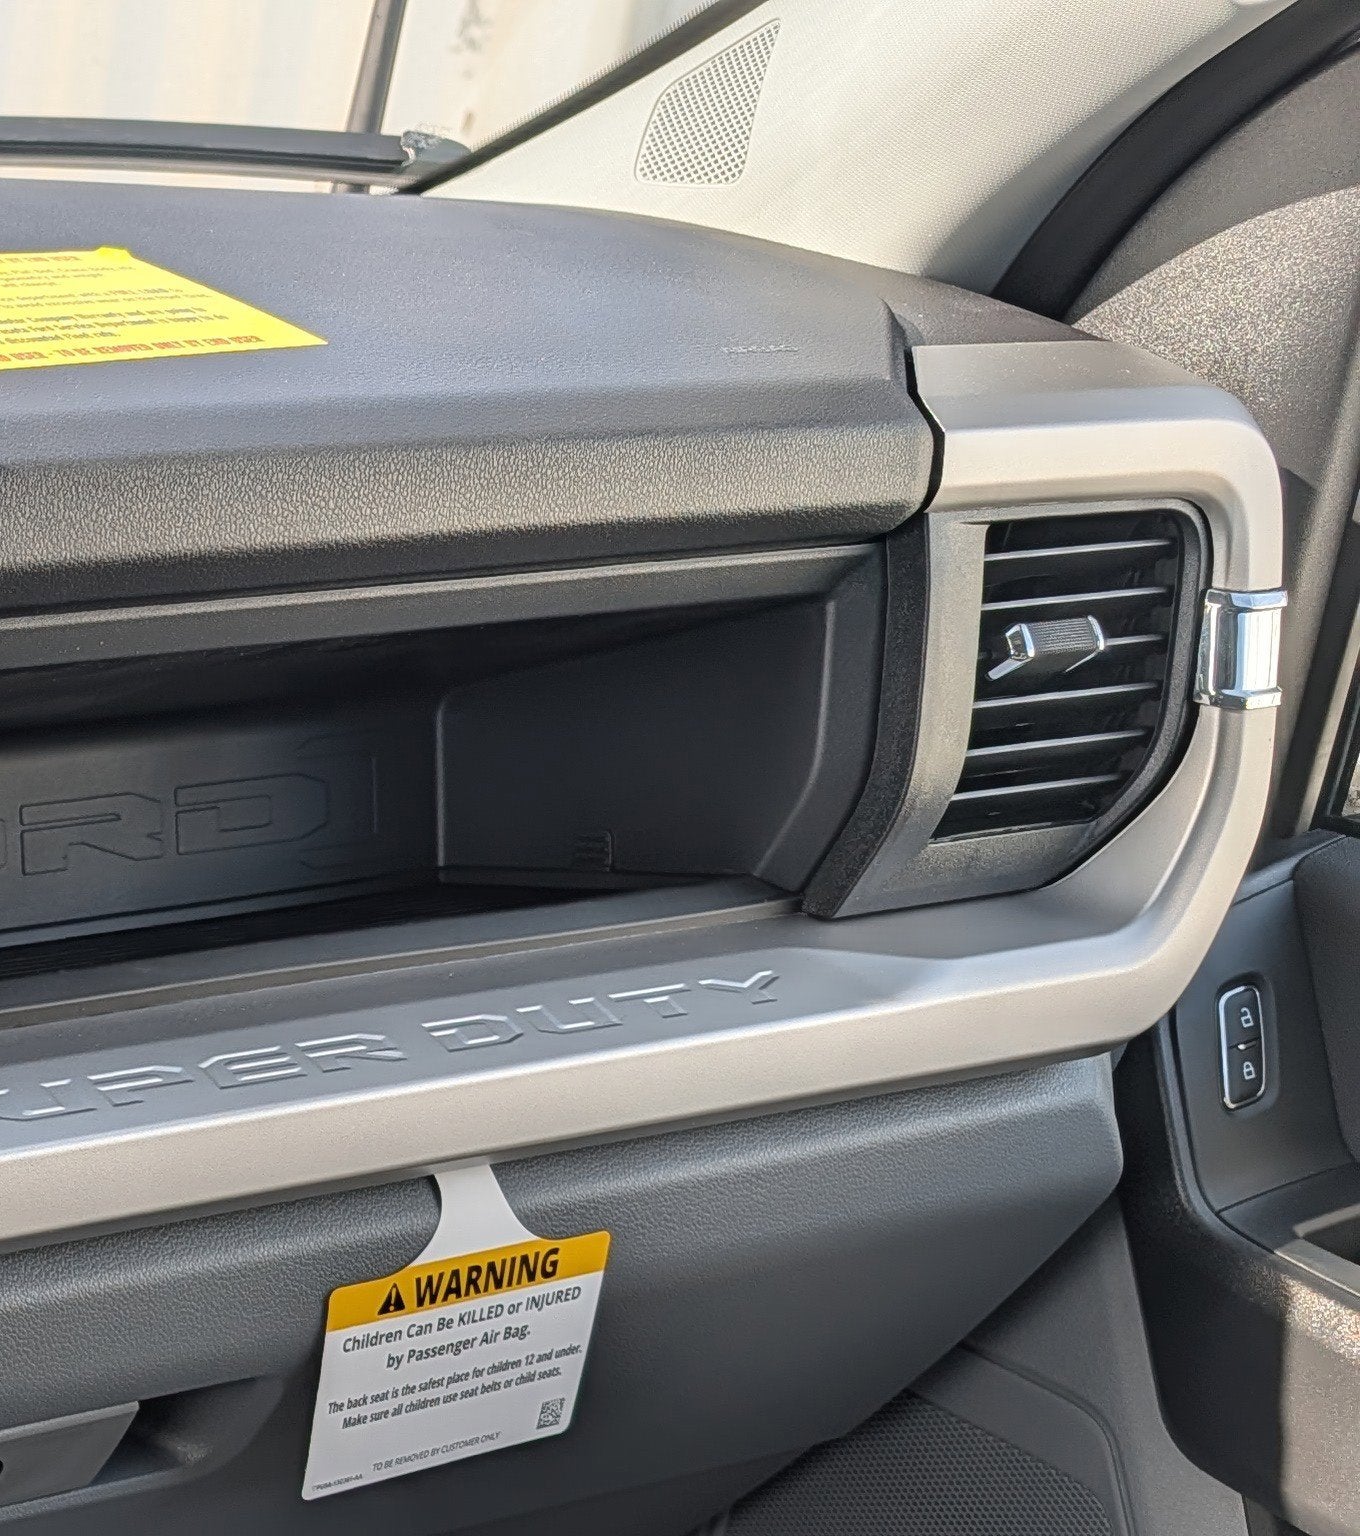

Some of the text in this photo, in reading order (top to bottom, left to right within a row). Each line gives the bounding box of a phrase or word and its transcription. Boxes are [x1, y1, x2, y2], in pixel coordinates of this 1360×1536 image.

[420, 969, 781, 1055] DUTY
[415, 1247, 560, 1308] WARNING
[343, 1286, 581, 1352] Children Can Be KILLED or INJURED
[386, 1324, 530, 1370] by Passenger Air Bag.
[328, 1343, 582, 1414] The back seat is the safest place for children 12 and under.
[342, 1366, 561, 1429] Make sure all children use seat belts or child seats.
[372, 1462, 382, 1471] TO
[384, 1459, 393, 1469] BE
[394, 1450, 430, 1465] REMOVED
[431, 1447, 441, 1456] BY
[441, 1436, 480, 1453] CUSTOMER
